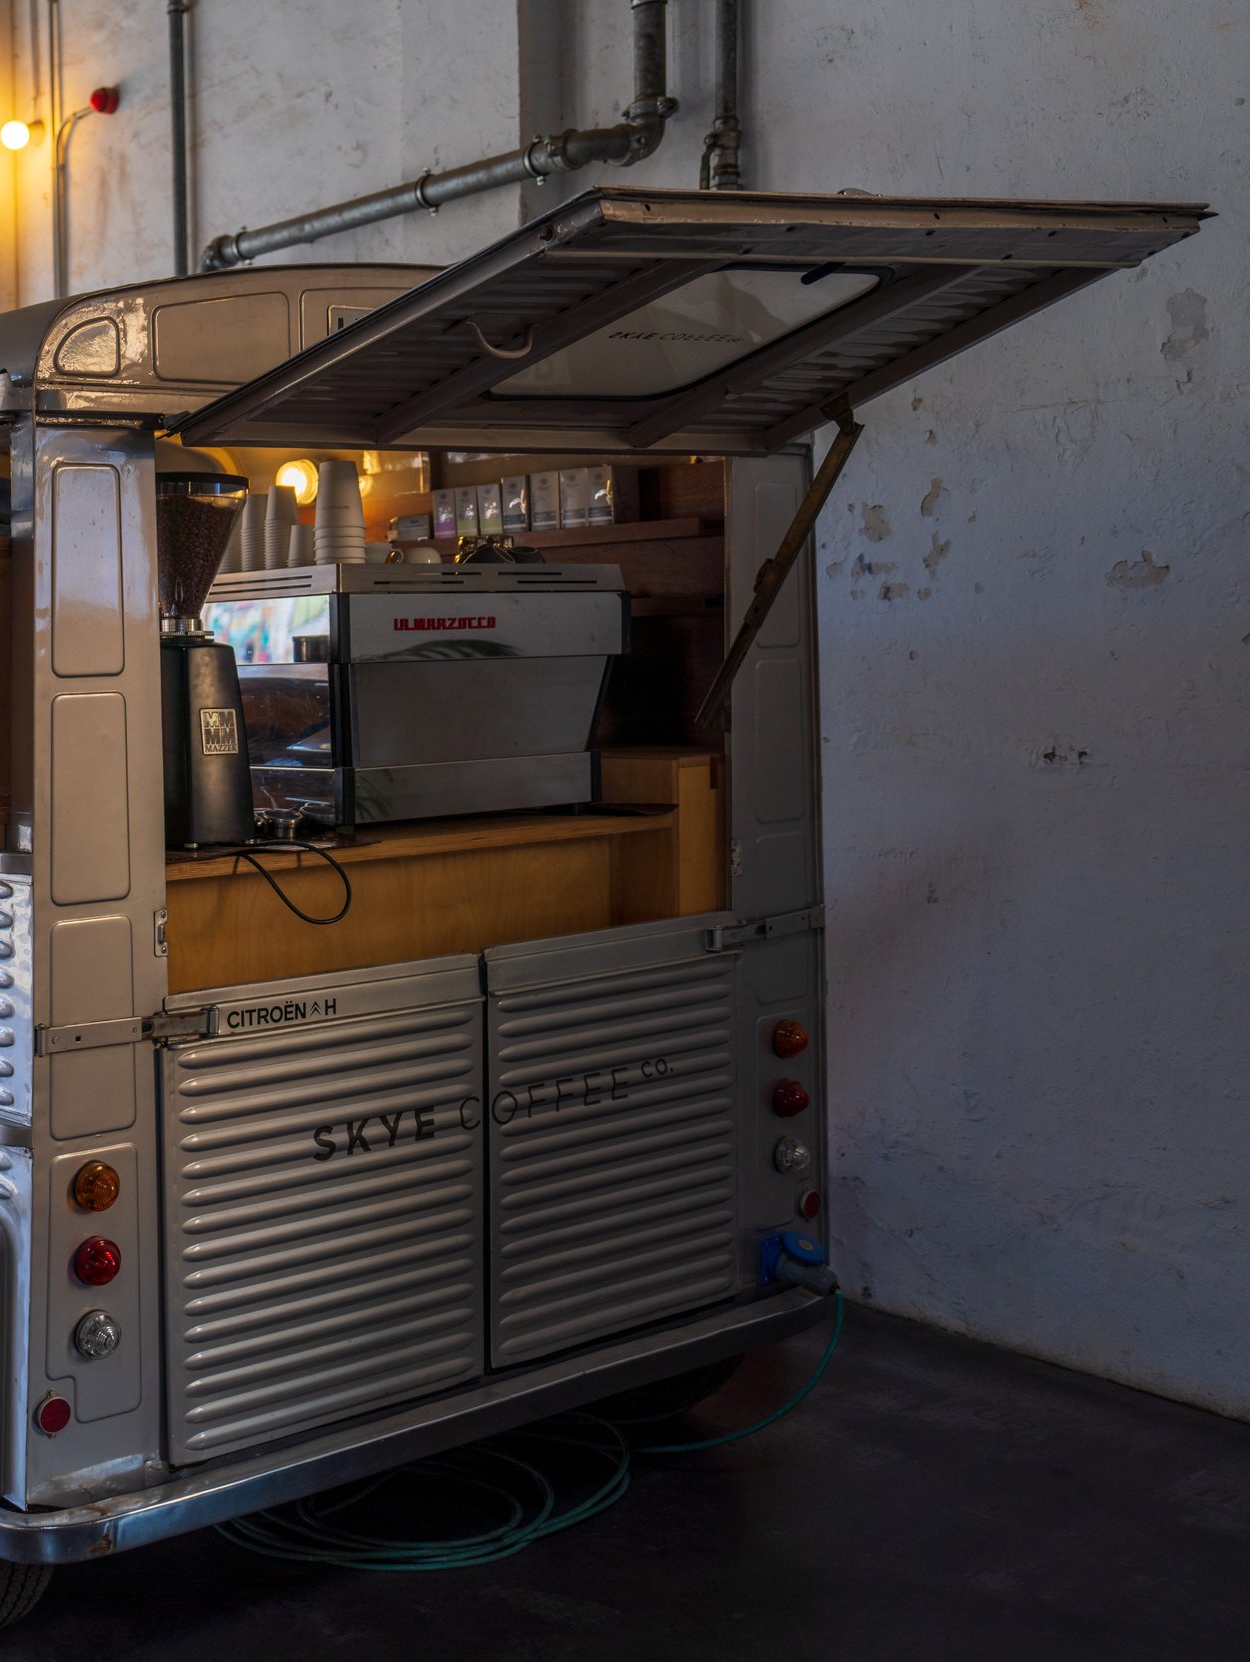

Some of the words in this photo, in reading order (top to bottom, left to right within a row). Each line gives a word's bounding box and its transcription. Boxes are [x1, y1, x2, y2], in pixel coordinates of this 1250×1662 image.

[226, 1001, 307, 1029] CITROËN
[324, 999, 337, 1015] H
[313, 1104, 436, 1161] SKYE
[459, 1066, 629, 1131] COFFEE
[641, 1056, 674, 1078] CO.
